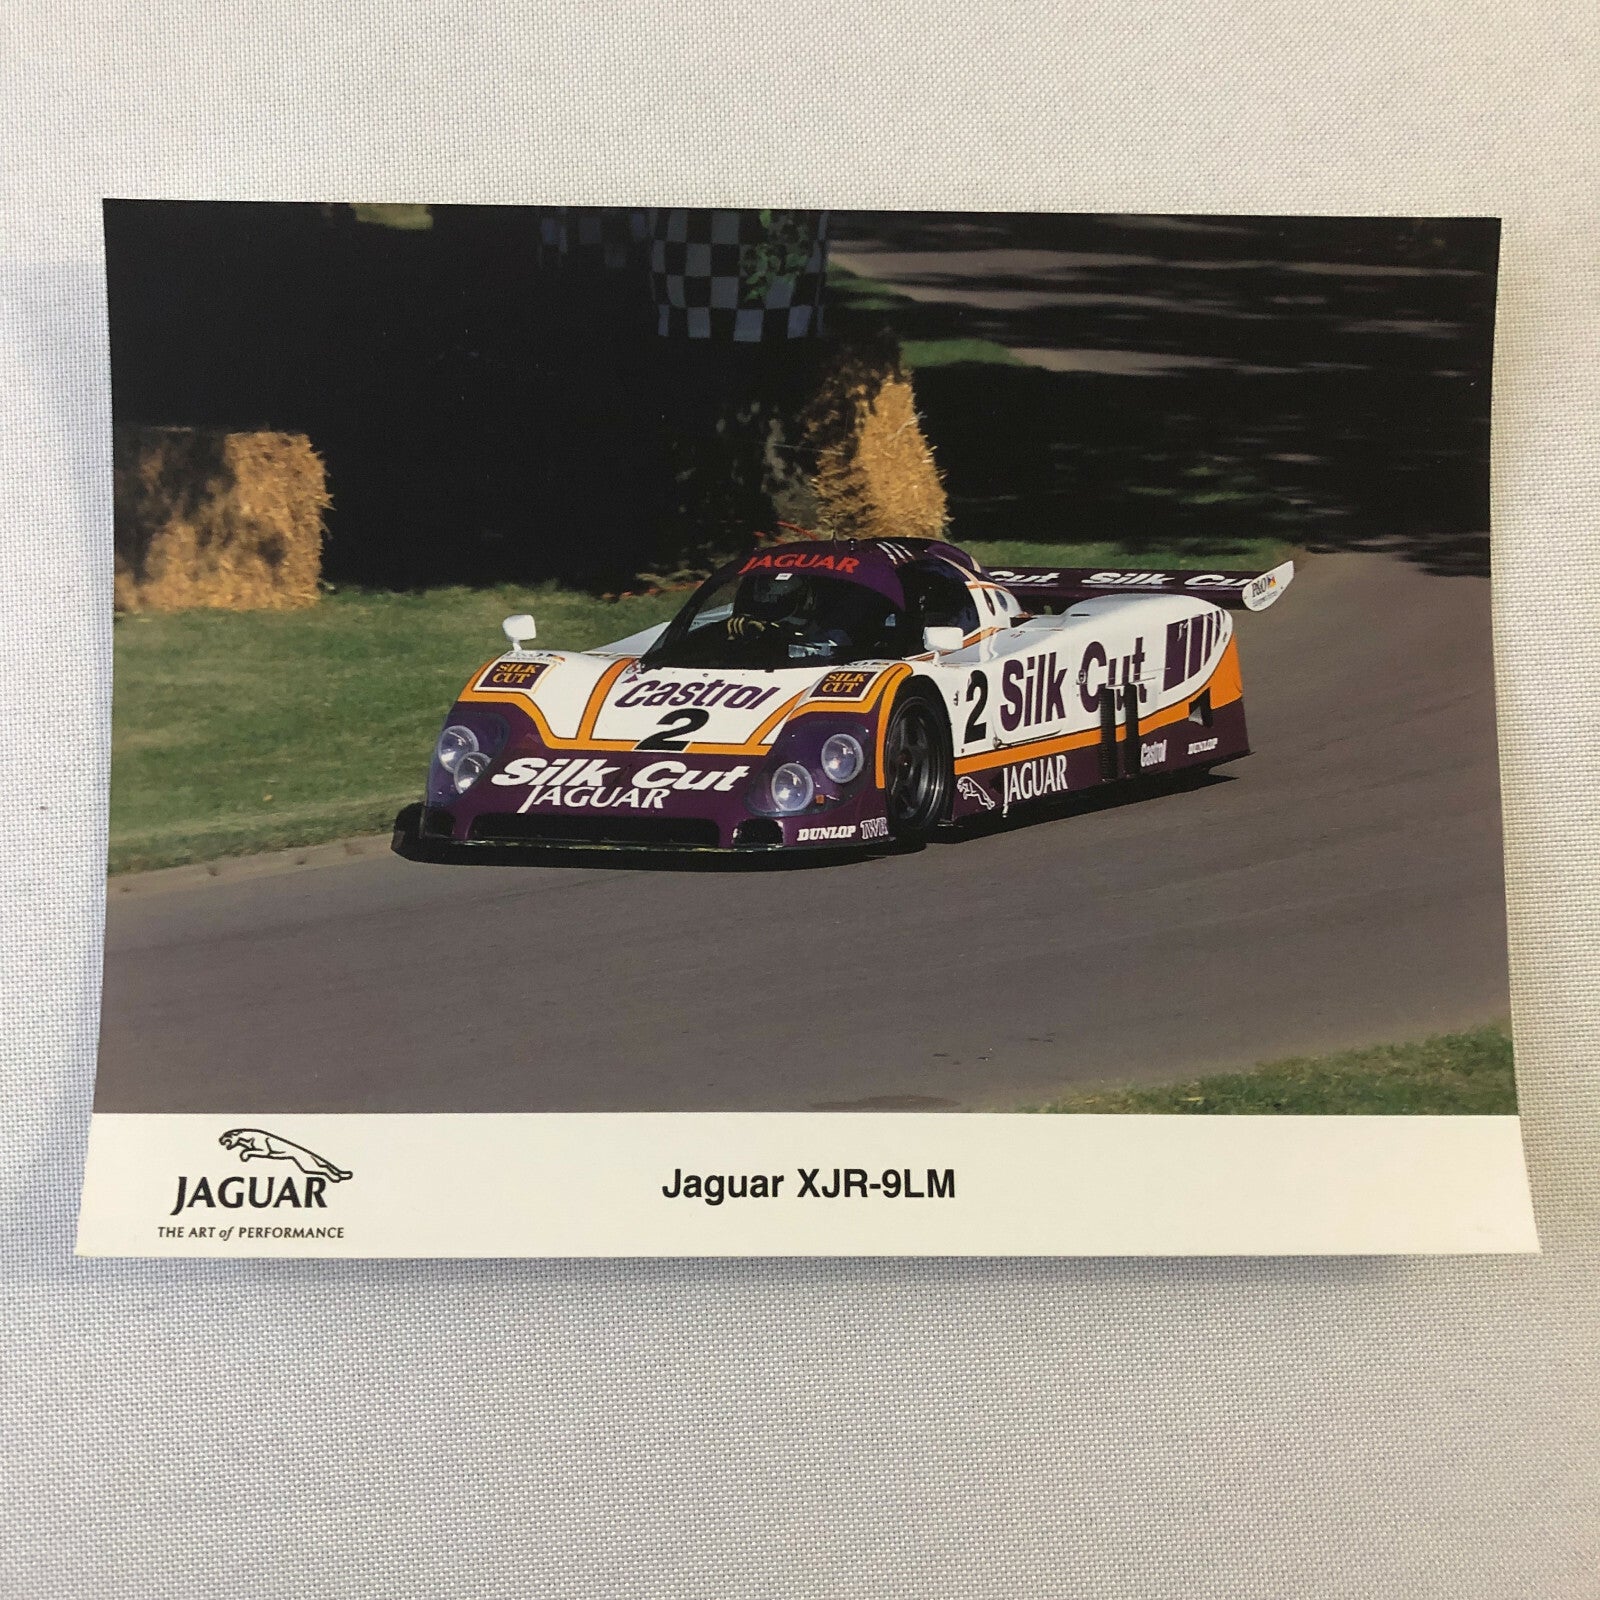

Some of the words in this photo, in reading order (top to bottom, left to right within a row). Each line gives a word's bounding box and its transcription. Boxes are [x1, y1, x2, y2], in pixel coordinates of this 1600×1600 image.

[738, 553, 860, 574] JAGUAR
[988, 570, 1060, 583] Cut
[1081, 572, 1175, 585] Silk
[1184, 574, 1254, 587] Cu
[492, 672, 531, 684] CUT
[497, 663, 541, 674] SILK
[825, 672, 869, 683] SILK
[614, 679, 781, 710] Castrol
[821, 681, 860, 693] CUT
[1000, 651, 1067, 732] Silk
[963, 669, 989, 745] 2
[633, 707, 710, 752] 2
[491, 757, 622, 788] Silk
[631, 759, 751, 792] Cut
[1002, 754, 1069, 815] JAGUAR
[516, 785, 673, 814] JAGUAR
[797, 825, 857, 842] DUNLOP
[170, 1176, 328, 1216] JAGUAR
[662, 1168, 785, 1206] Jaguar
[796, 1168, 956, 1199] XJR-9LM
[157, 1226, 185, 1239] THE
[188, 1226, 216, 1239] ART
[218, 1226, 235, 1242] of
[238, 1226, 345, 1239] PERFORMANCE
